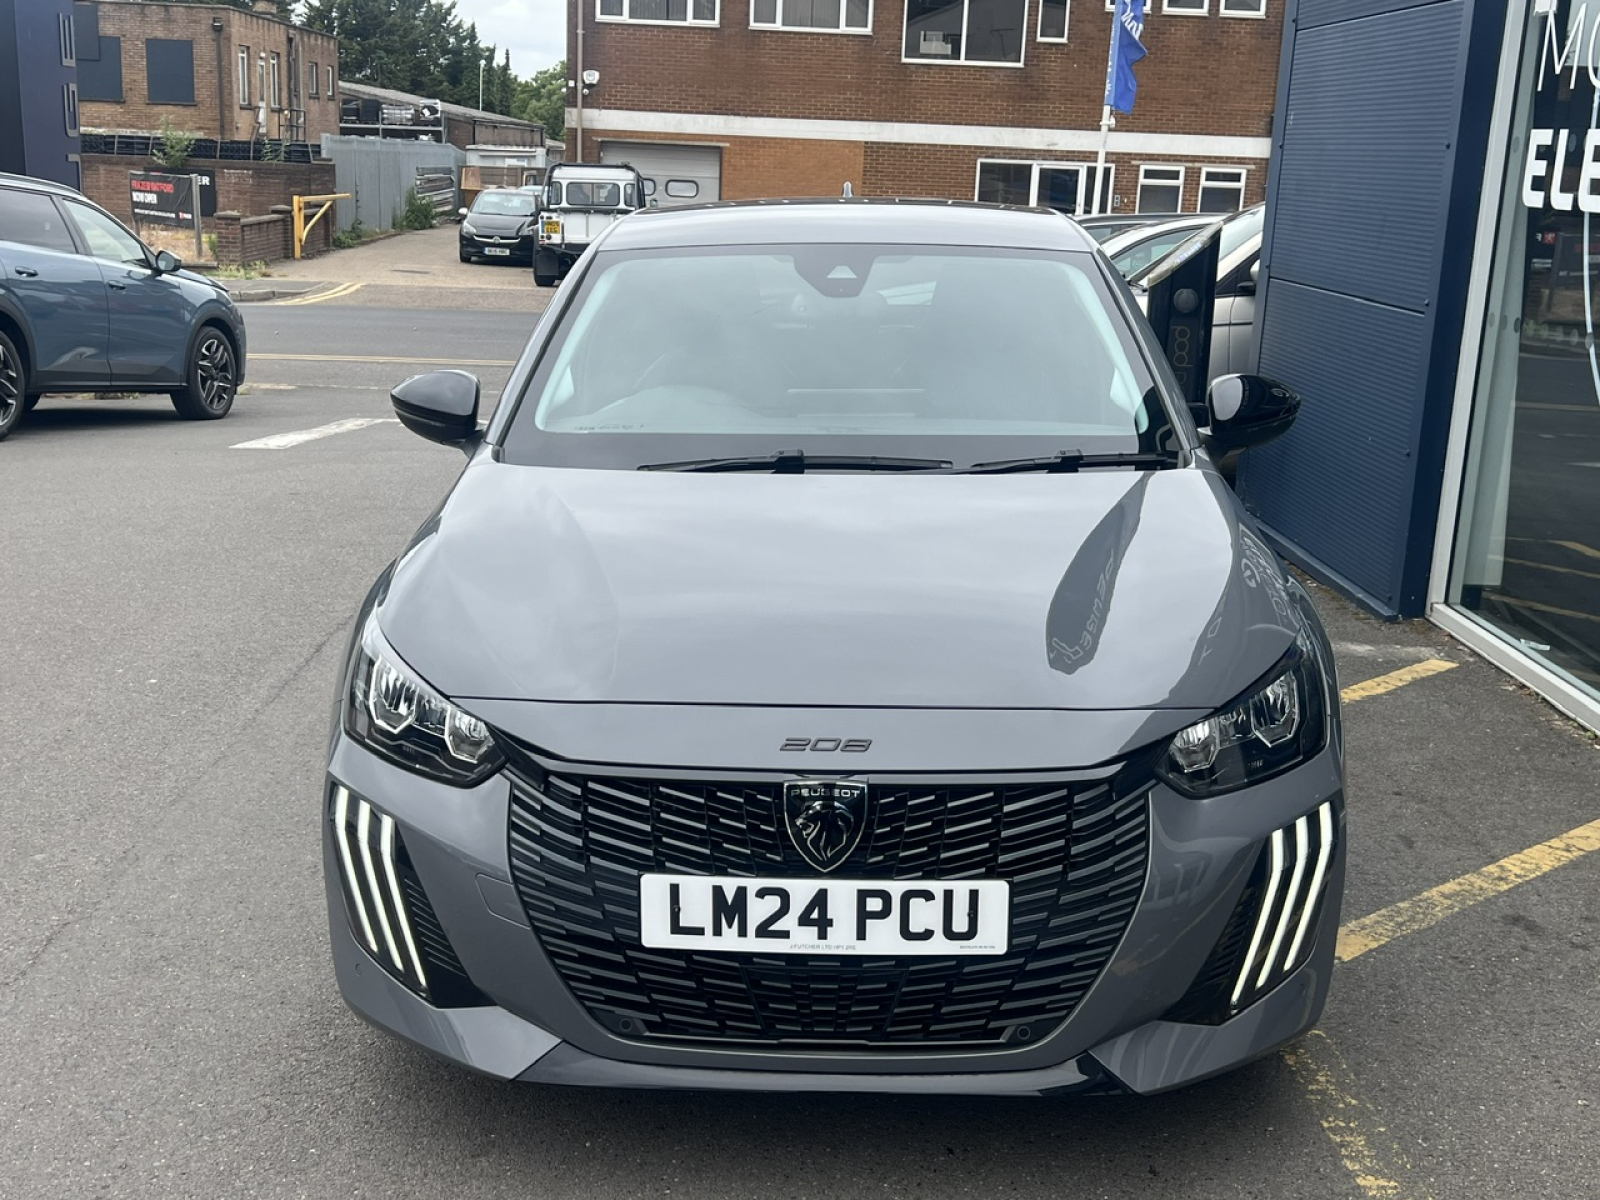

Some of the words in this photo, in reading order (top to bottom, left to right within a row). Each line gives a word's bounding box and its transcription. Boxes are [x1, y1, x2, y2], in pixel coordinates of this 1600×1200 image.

[780, 737, 873, 753] 208
[790, 787, 861, 798] PEUGEOT
[669, 883, 834, 940] LM24
[856, 889, 980, 941] PCU
